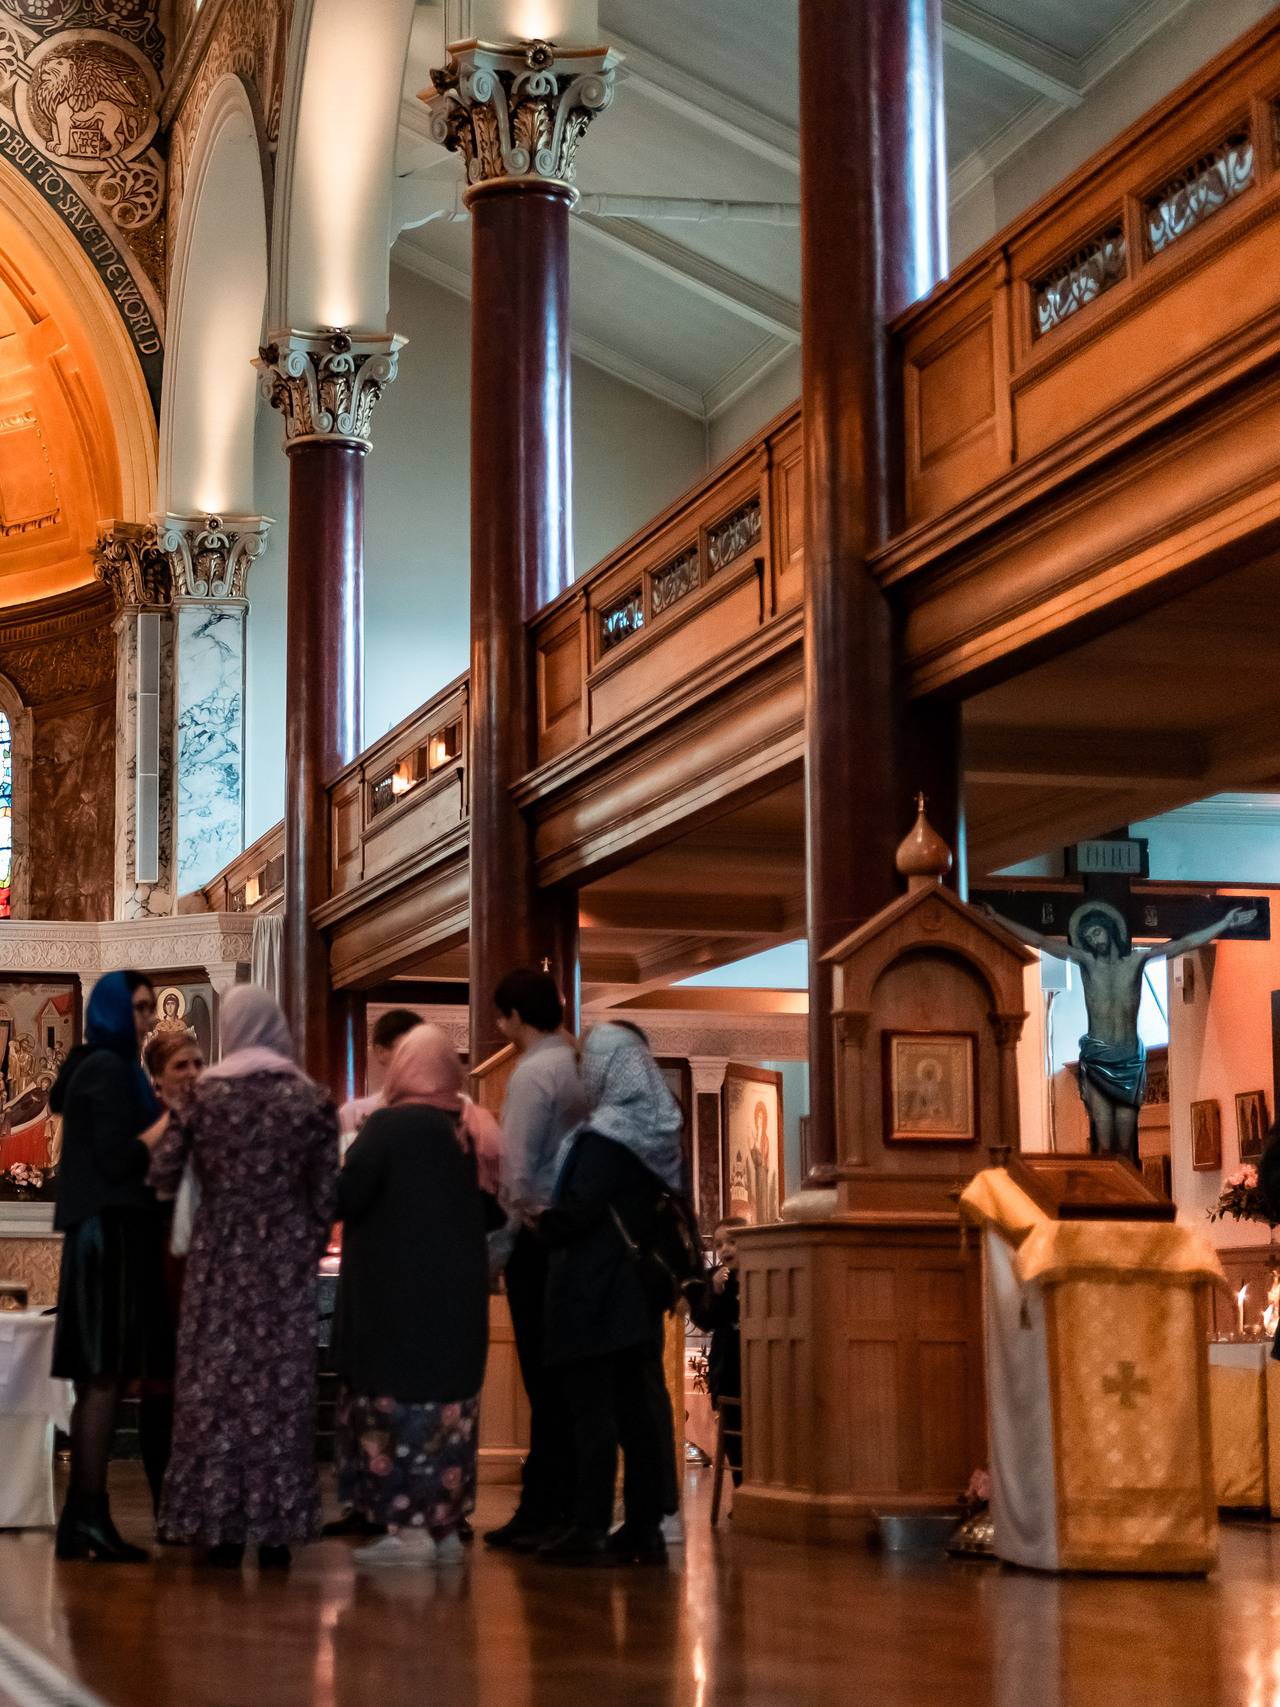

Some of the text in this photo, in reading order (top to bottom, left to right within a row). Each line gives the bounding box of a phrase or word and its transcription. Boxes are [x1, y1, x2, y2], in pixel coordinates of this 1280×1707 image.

[4, 134, 46, 174] BUT
[37, 165, 64, 195] TO
[57, 193, 102, 242] SAVE
[114, 275, 160, 355] WORLD
